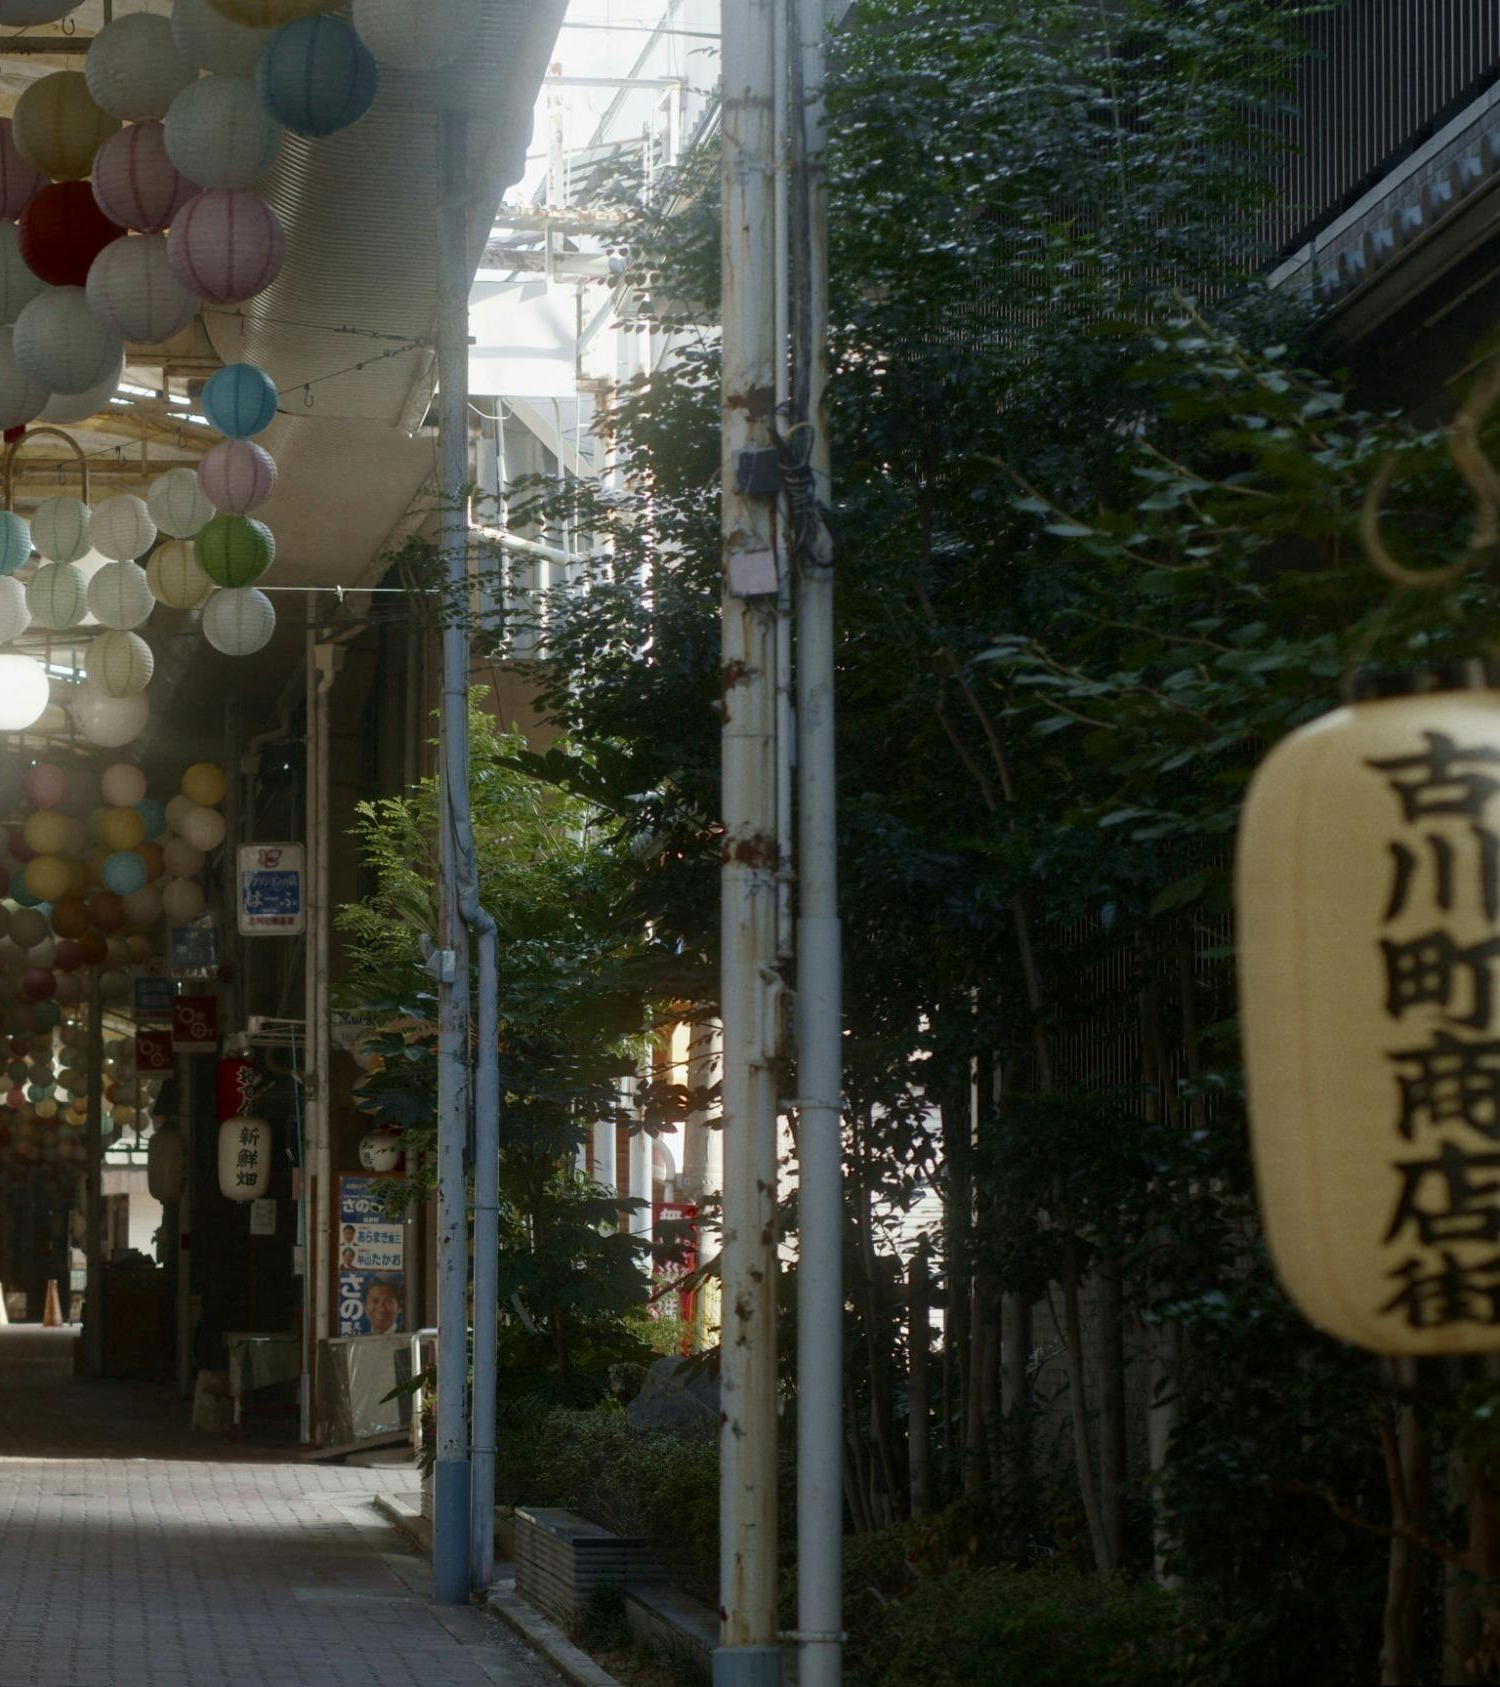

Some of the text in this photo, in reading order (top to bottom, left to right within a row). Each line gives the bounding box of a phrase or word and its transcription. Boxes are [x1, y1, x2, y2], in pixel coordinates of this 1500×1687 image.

[236, 1126, 261, 1187] 新鮮畑
[1365, 730, 1500, 1328] 古川町商店街
